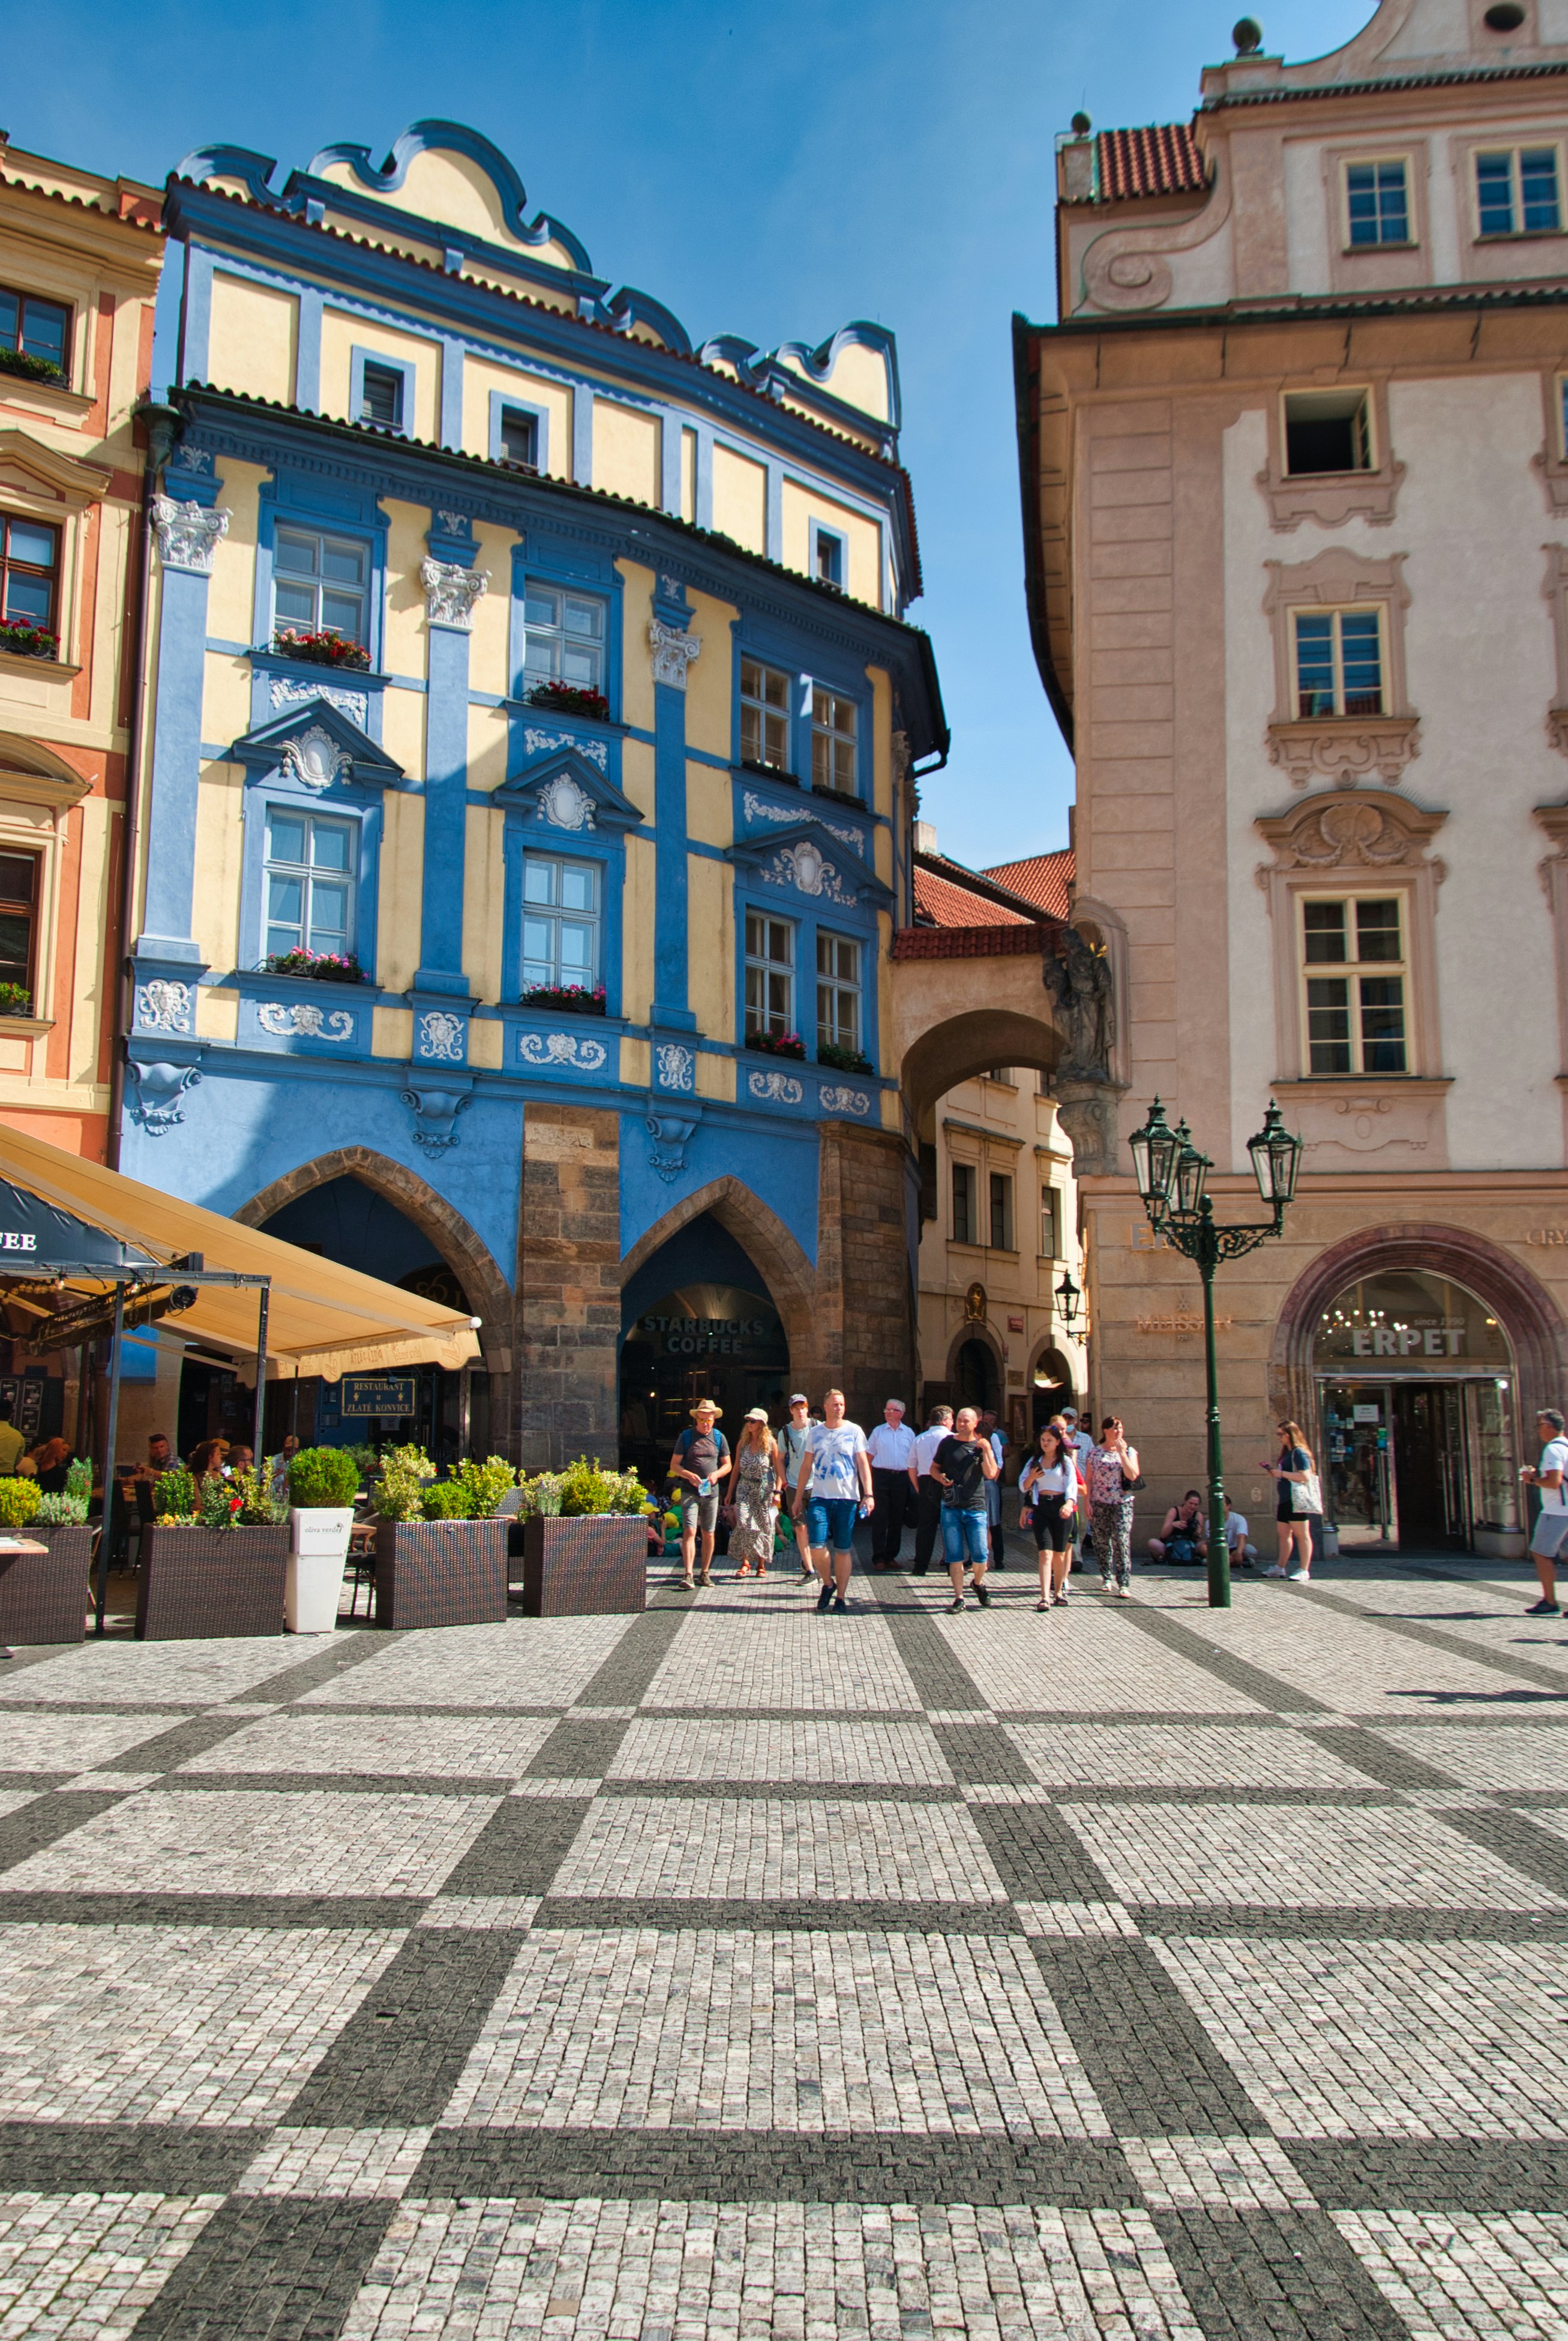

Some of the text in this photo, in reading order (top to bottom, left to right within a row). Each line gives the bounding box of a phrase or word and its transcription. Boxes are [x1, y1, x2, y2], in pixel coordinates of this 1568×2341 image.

[0, 1232, 37, 1250] EE
[644, 1316, 764, 1335] STARBUCKS
[1136, 1315, 1231, 1331] MEISSN
[1414, 1317, 1437, 1326] since
[668, 1337, 743, 1354] COFFEE
[1353, 1328, 1465, 1355] ERPET
[354, 1382, 404, 1391] RESTAURANT
